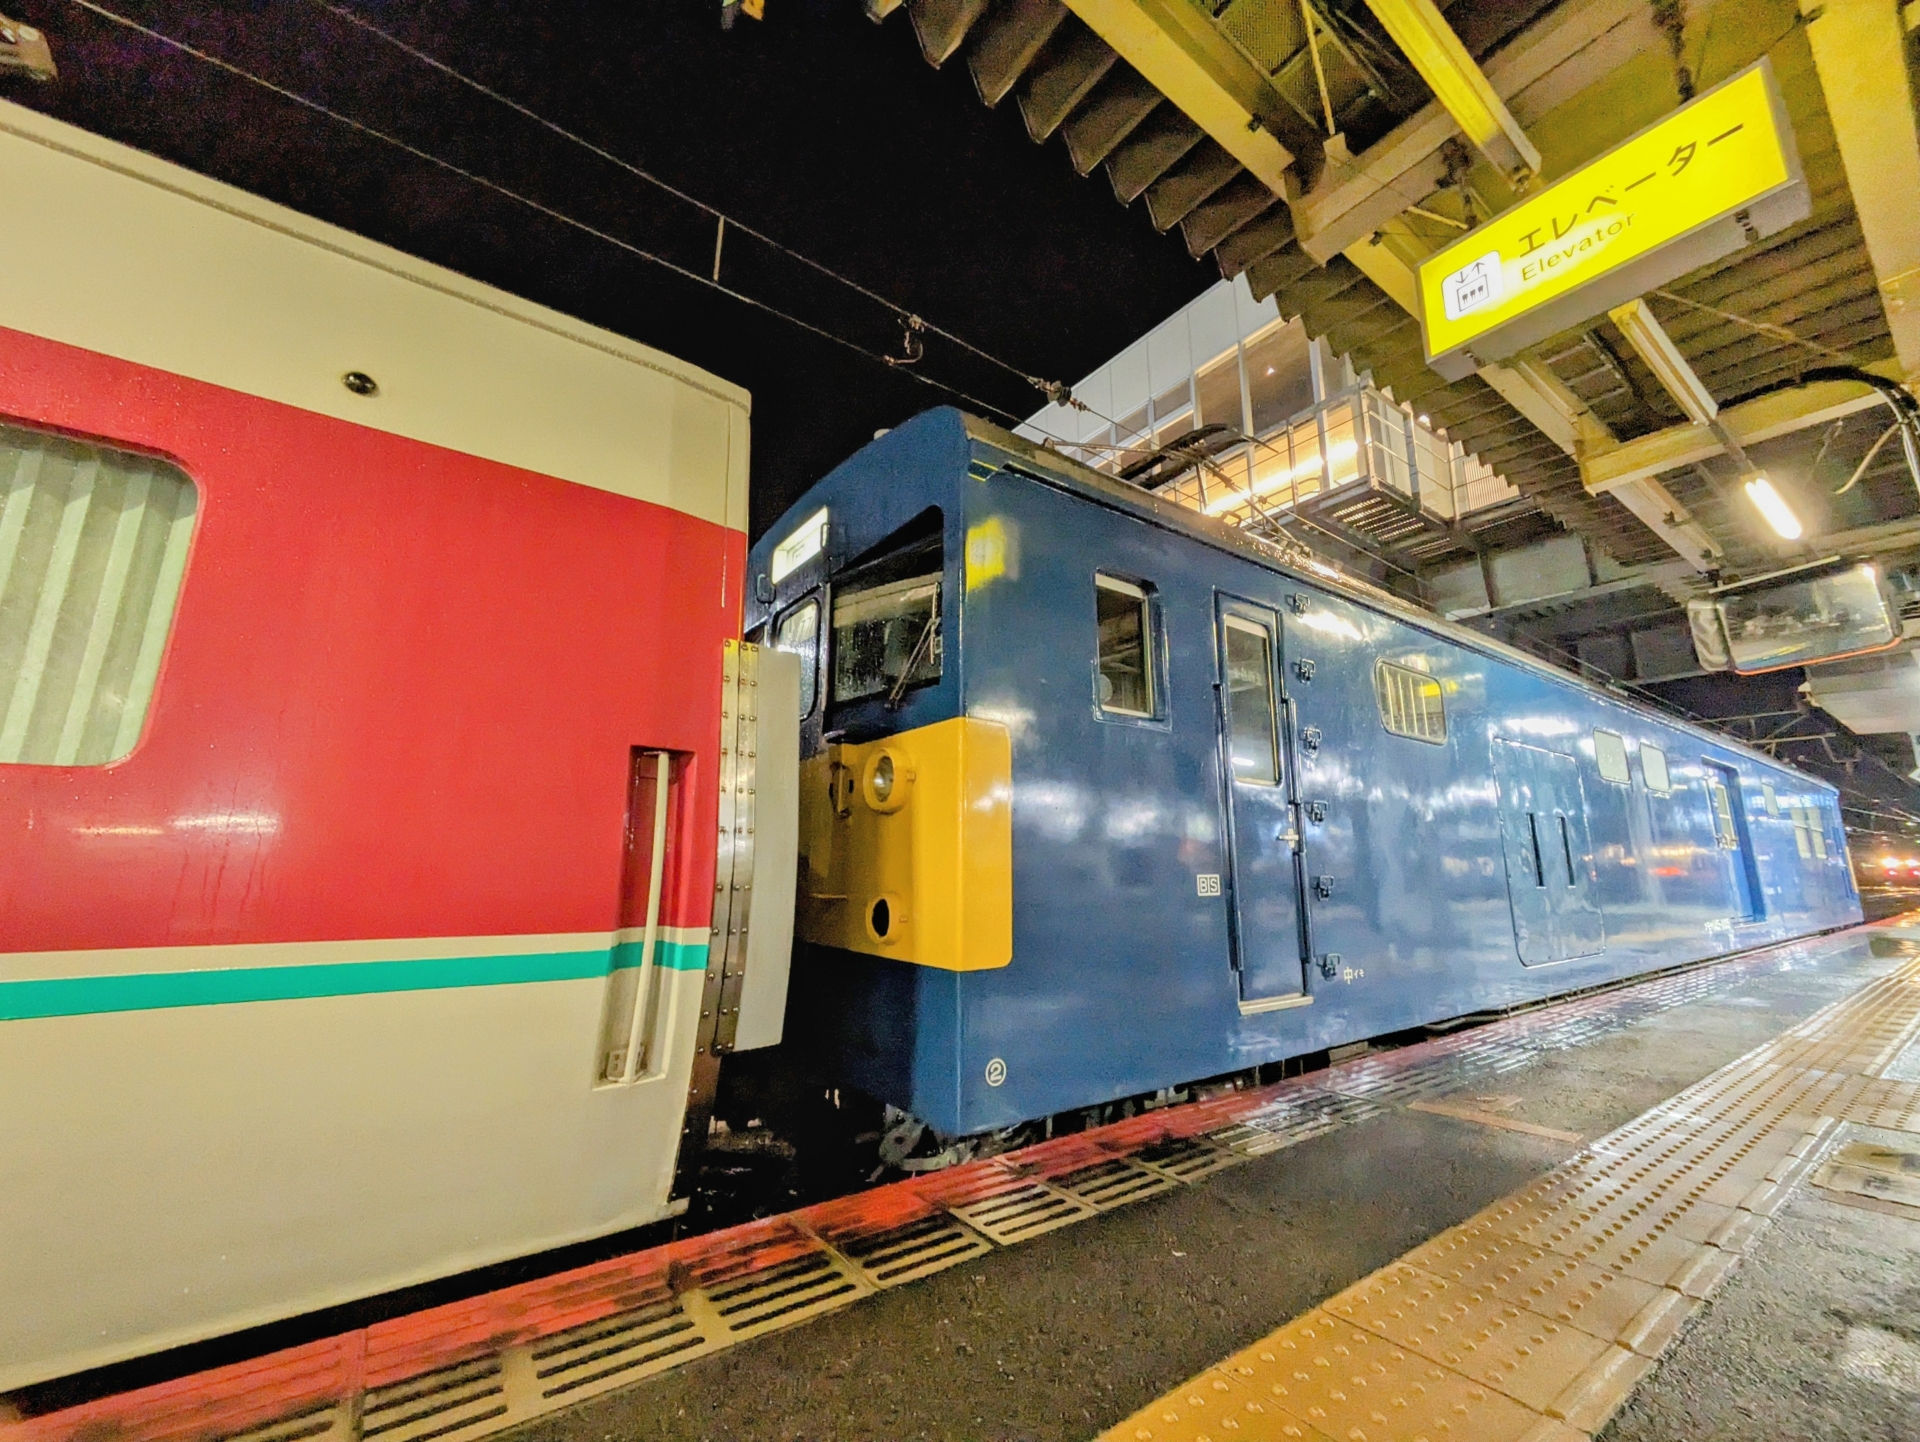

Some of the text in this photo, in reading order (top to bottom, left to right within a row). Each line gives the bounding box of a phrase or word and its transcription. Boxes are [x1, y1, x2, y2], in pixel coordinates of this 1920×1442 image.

[1518, 123, 1744, 258] エレベーター
[1522, 212, 1636, 281] Elevator
[1200, 877, 1218, 893] BS
